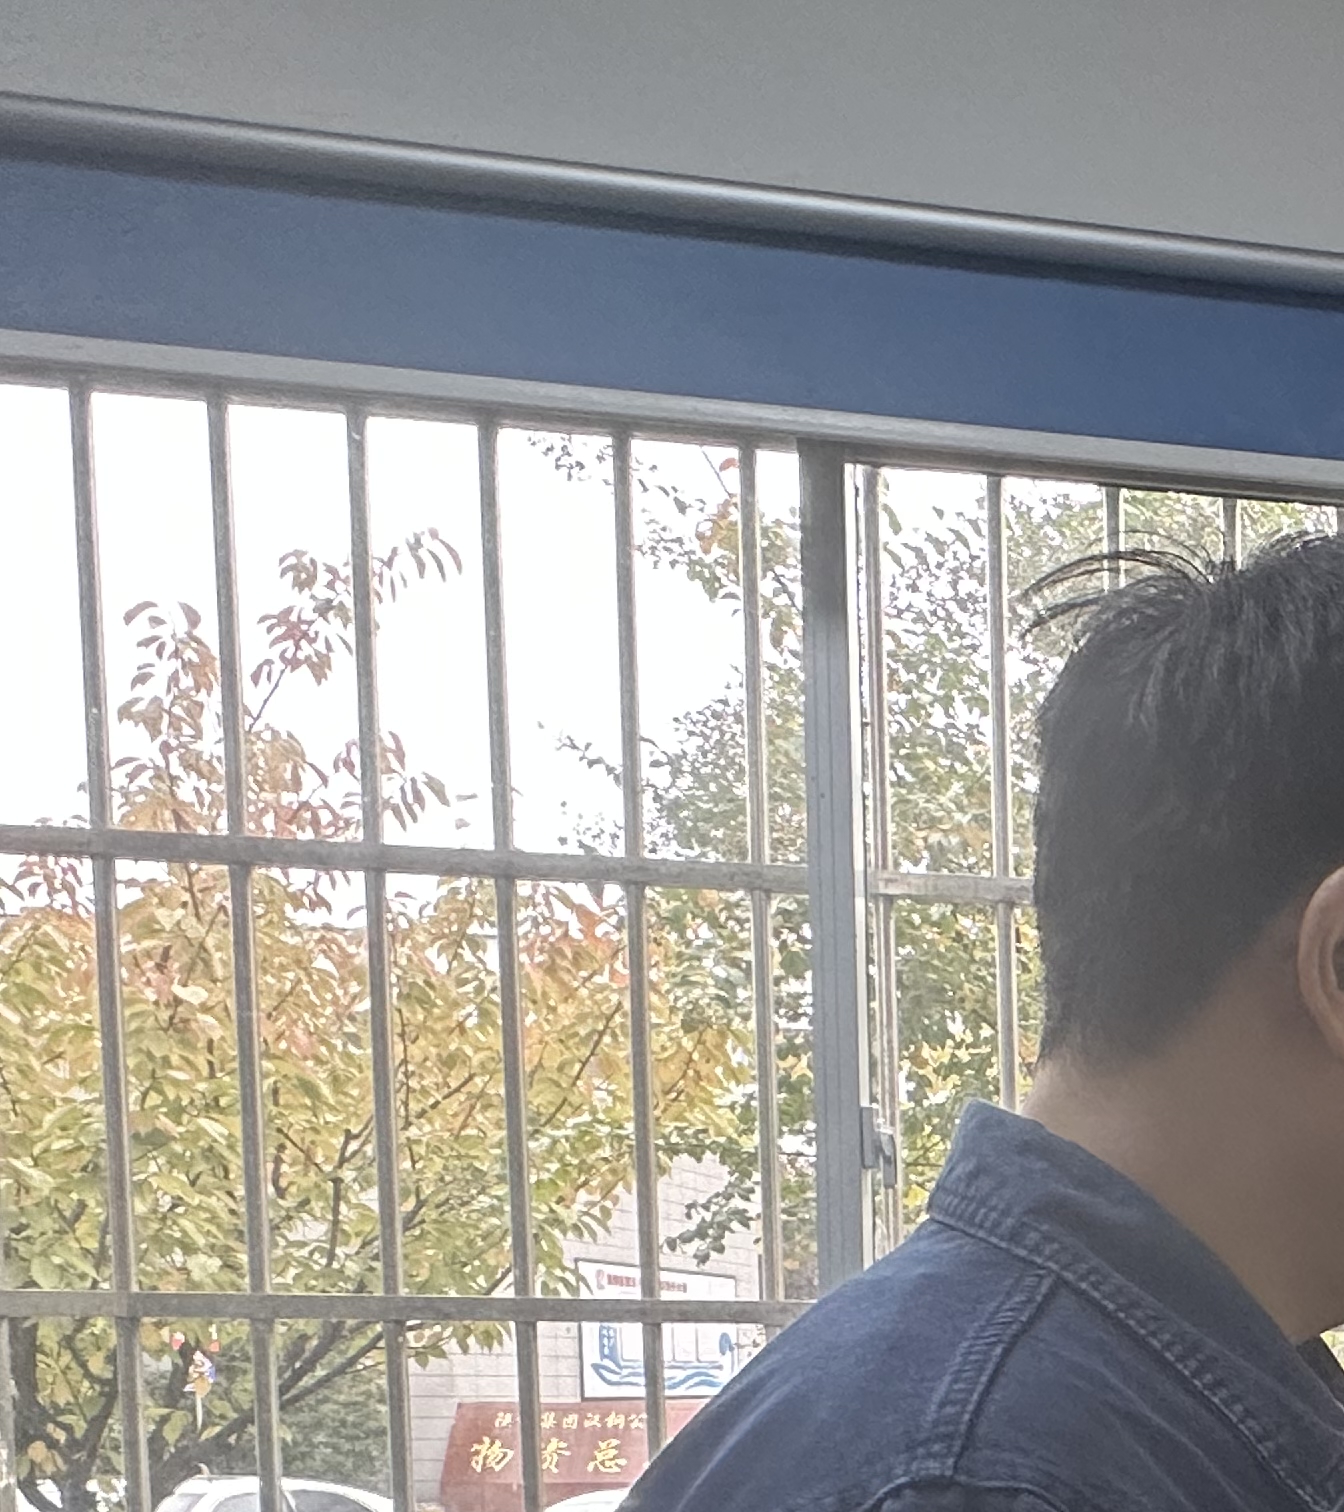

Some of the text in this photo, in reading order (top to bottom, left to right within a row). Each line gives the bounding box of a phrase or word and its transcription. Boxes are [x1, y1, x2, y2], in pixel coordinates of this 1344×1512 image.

[494, 1411, 649, 1430] 陕集团汉钢公
[470, 1436, 649, 1474] 物资总
